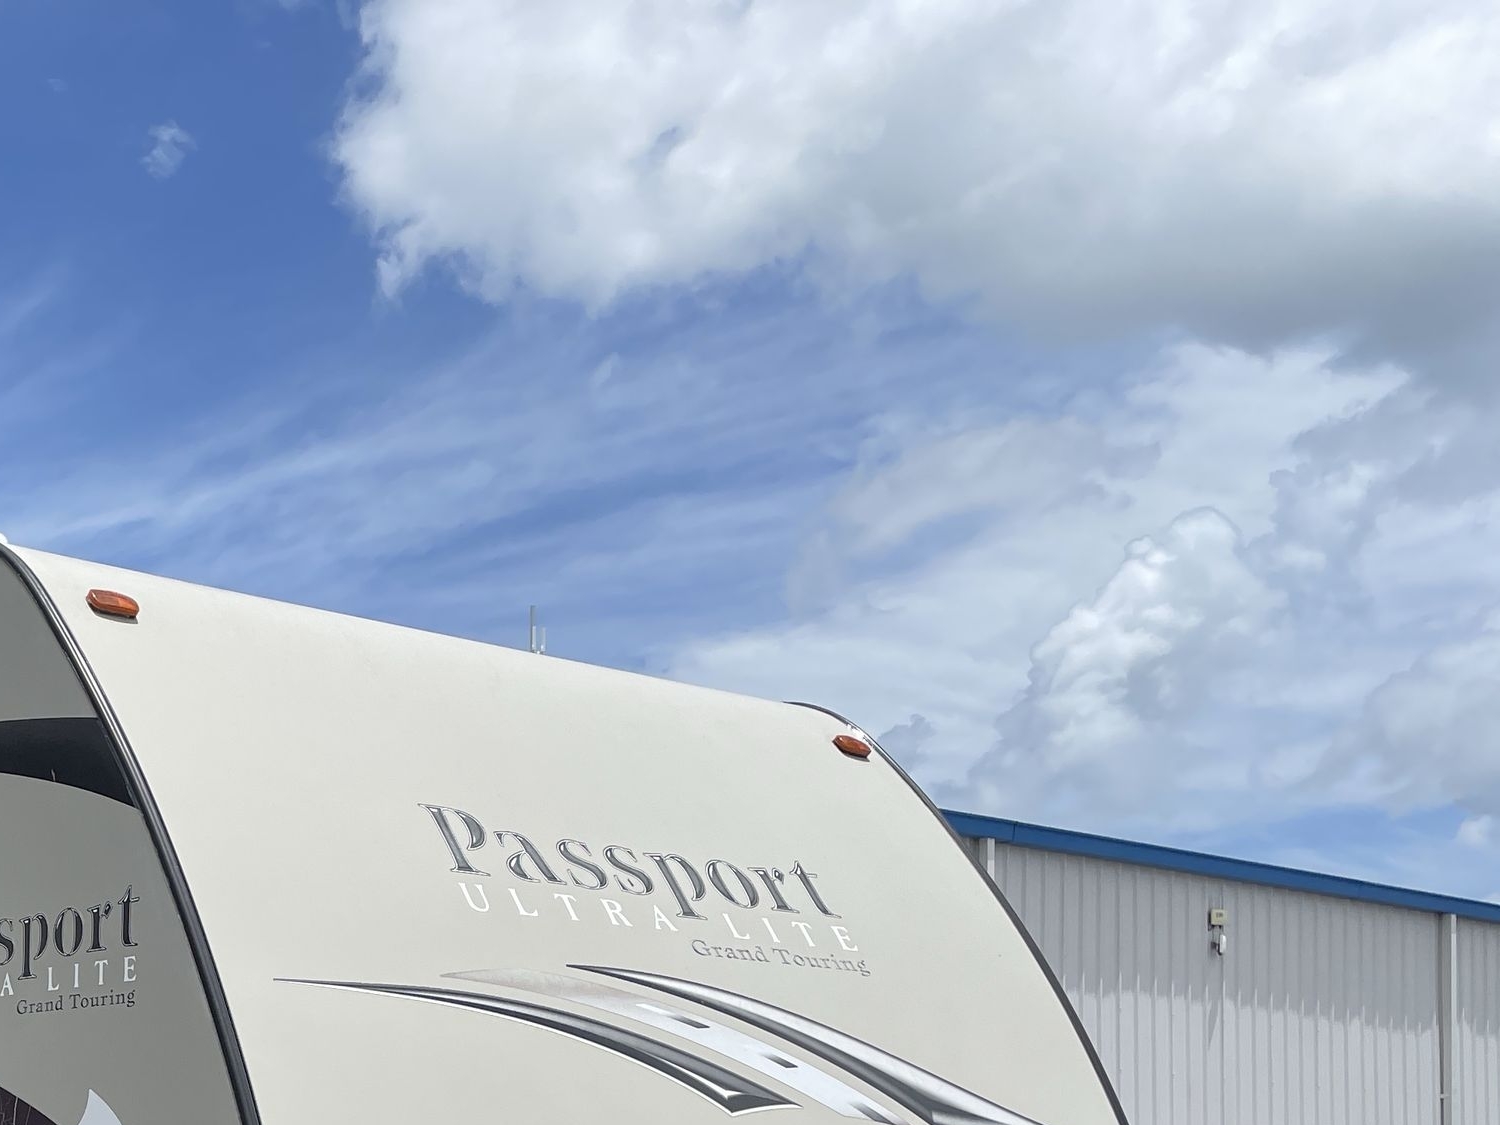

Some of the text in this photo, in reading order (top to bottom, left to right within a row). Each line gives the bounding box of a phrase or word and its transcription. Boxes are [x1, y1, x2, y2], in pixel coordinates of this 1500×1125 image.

[418, 802, 841, 920] Passport
[459, 882, 859, 952] ULTRA LITE
[47, 955, 138, 991] LITE
[692, 939, 872, 977] Grand Touring
[16, 989, 136, 1015] Grand Touring
